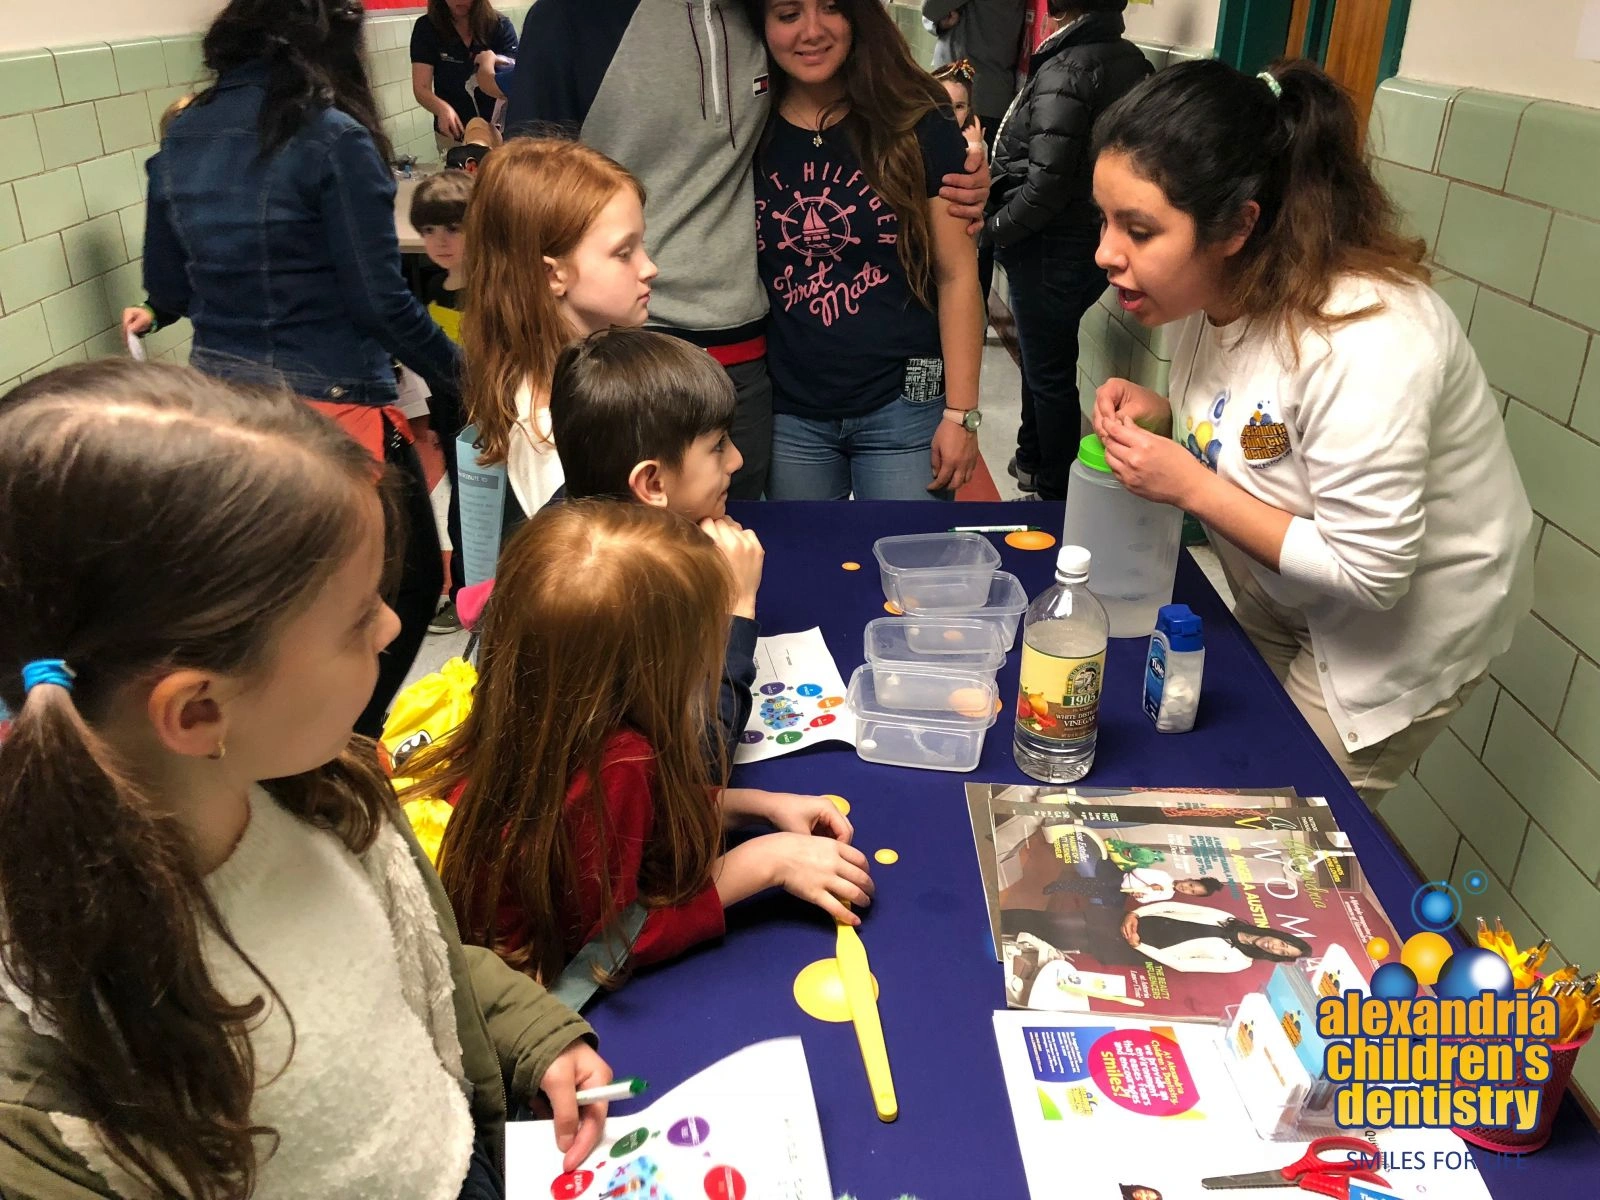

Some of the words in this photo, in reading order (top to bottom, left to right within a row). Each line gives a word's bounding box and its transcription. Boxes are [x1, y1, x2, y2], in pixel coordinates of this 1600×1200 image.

[803, 161, 898, 245] HILFIGER
[773, 260, 834, 313] First
[809, 261, 890, 327] Mate
[1070, 694, 1095, 706] 1905
[1230, 855, 1257, 893] ANGELA
[1245, 895, 1271, 929] AUSTIN
[1145, 962, 1161, 999] INFLUENCERS
[1155, 966, 1164, 977] THE
[1158, 977, 1171, 1000] BEAUTY
[1114, 1041, 1127, 1055] and
[1144, 1044, 1156, 1057] we
[1100, 1051, 1131, 1098] smiles!
[1119, 1056, 1141, 1104] encourages
[1129, 1058, 1144, 1081] eases
[1134, 1047, 1160, 1097] environment
[1146, 1058, 1167, 1088] provide
